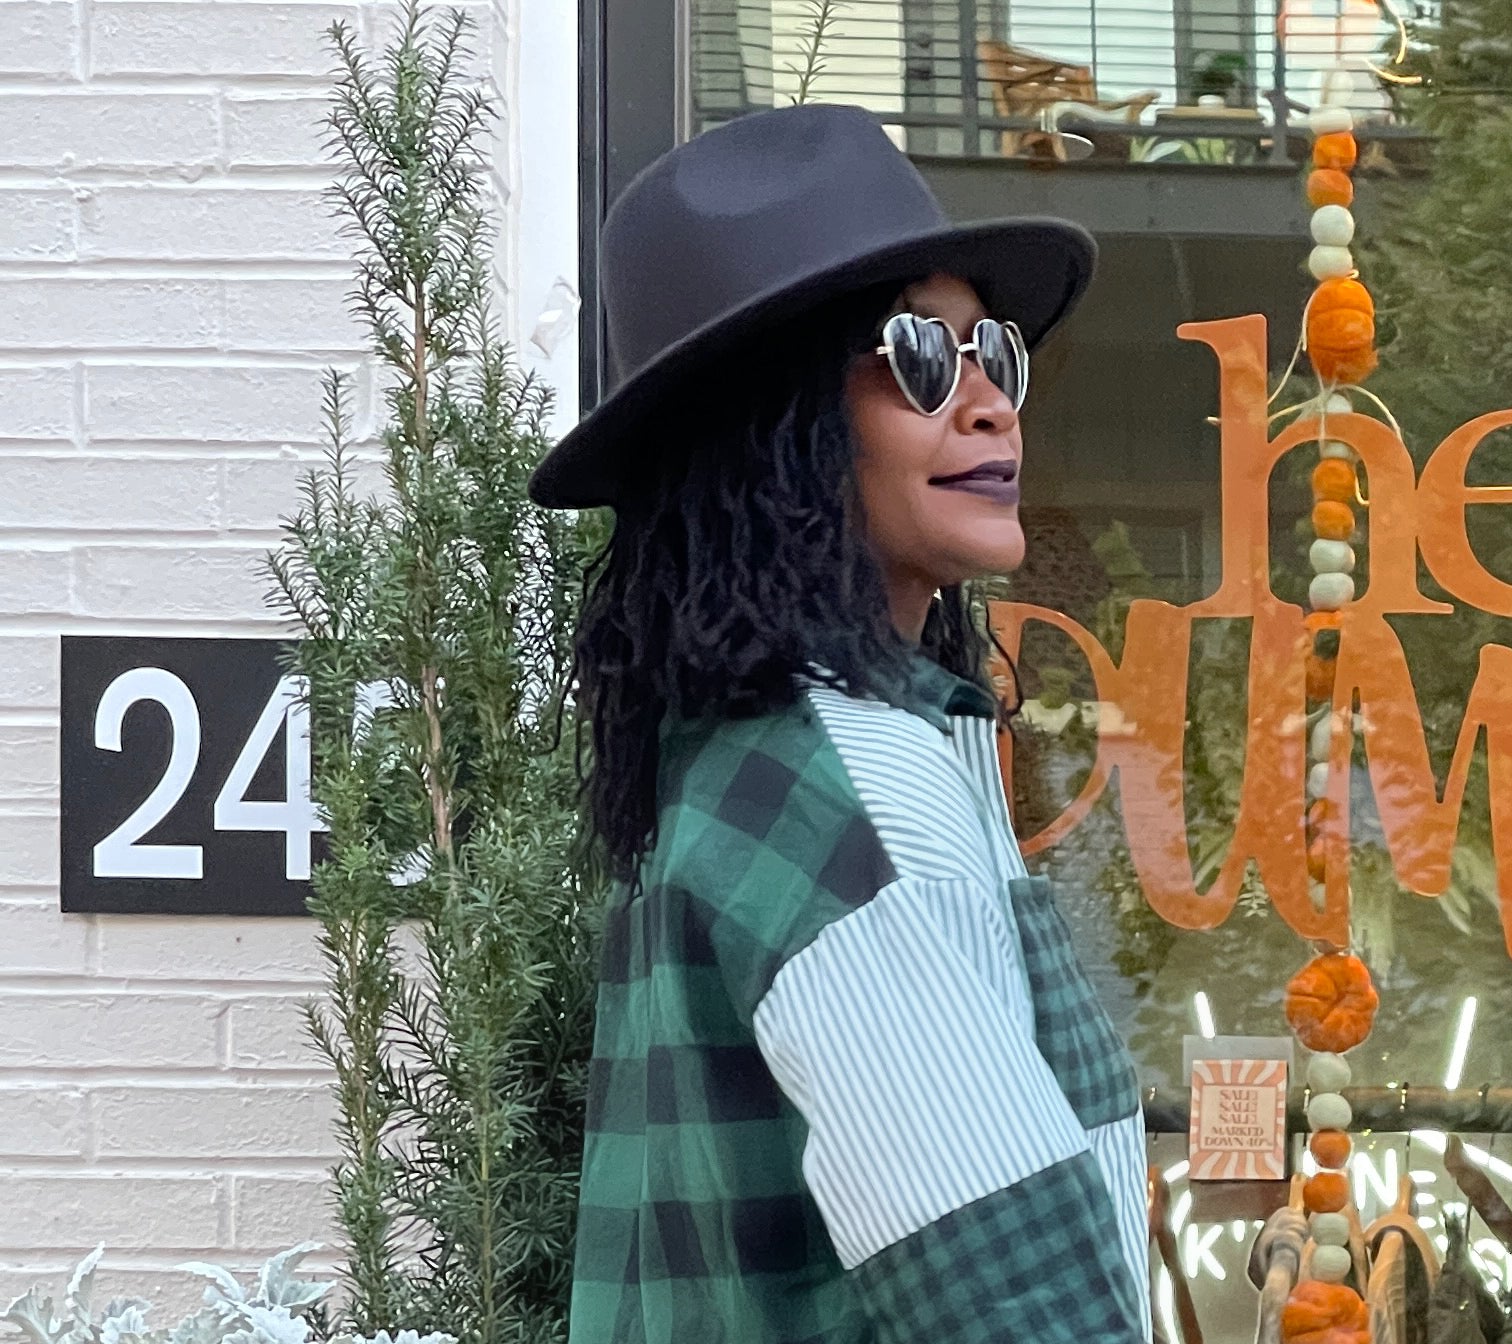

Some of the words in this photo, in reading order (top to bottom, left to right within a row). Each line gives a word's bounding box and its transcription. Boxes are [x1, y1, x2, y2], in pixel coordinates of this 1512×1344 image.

[94, 666, 433, 887] 24
[1211, 1126, 1264, 1136] MARKED
[1205, 1136, 1243, 1147] DOWN
